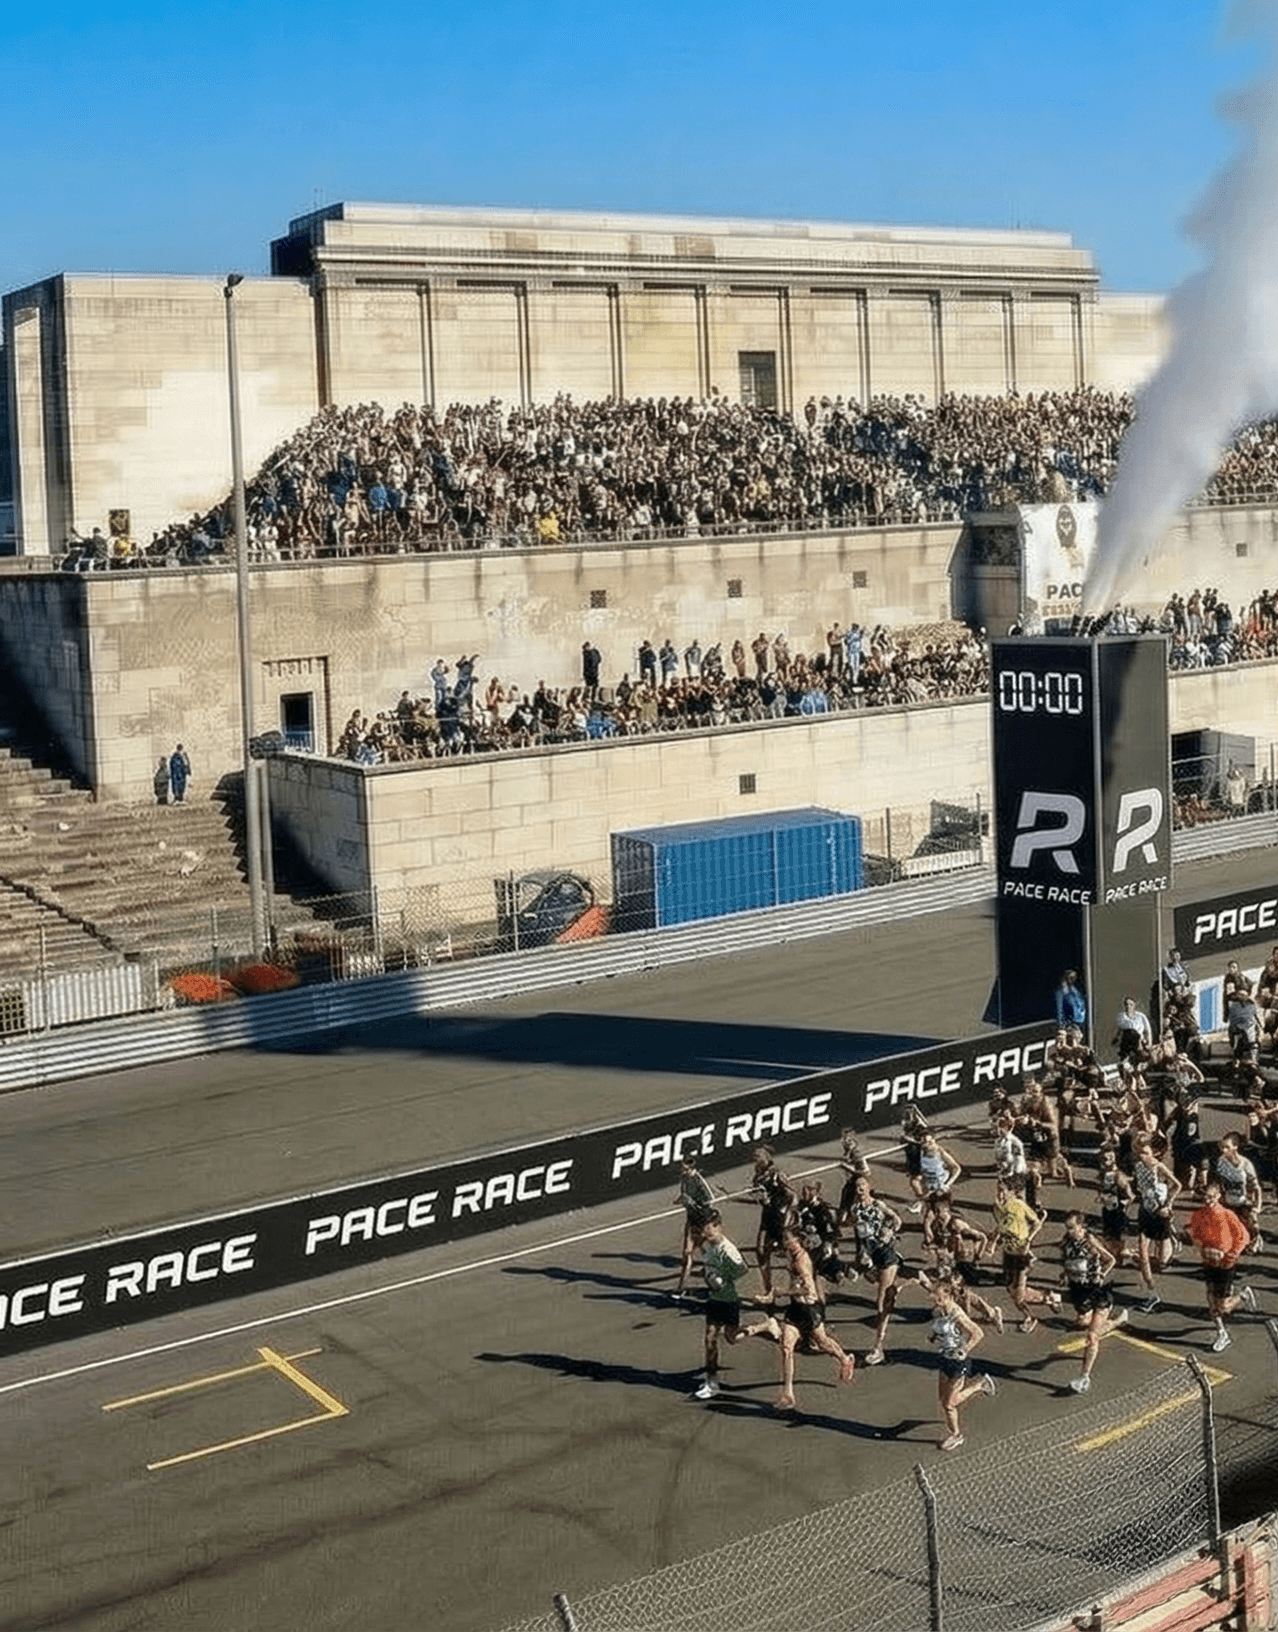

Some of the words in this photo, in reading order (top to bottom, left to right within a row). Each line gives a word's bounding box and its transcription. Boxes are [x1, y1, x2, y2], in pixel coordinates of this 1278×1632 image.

[1000, 672, 1082, 713] 00:00
[1004, 882, 1044, 898] PACE
[1048, 886, 1091, 905] RACE
[1106, 883, 1136, 903] PACE
[1139, 877, 1166, 893] RACE
[1195, 900, 1277, 943] PACE
[864, 1061, 963, 1113] PACE
[726, 1093, 831, 1147] RACE
[306, 1192, 438, 1254] PACE
[453, 1160, 572, 1217] RACE
[106, 1234, 256, 1302] RACE
